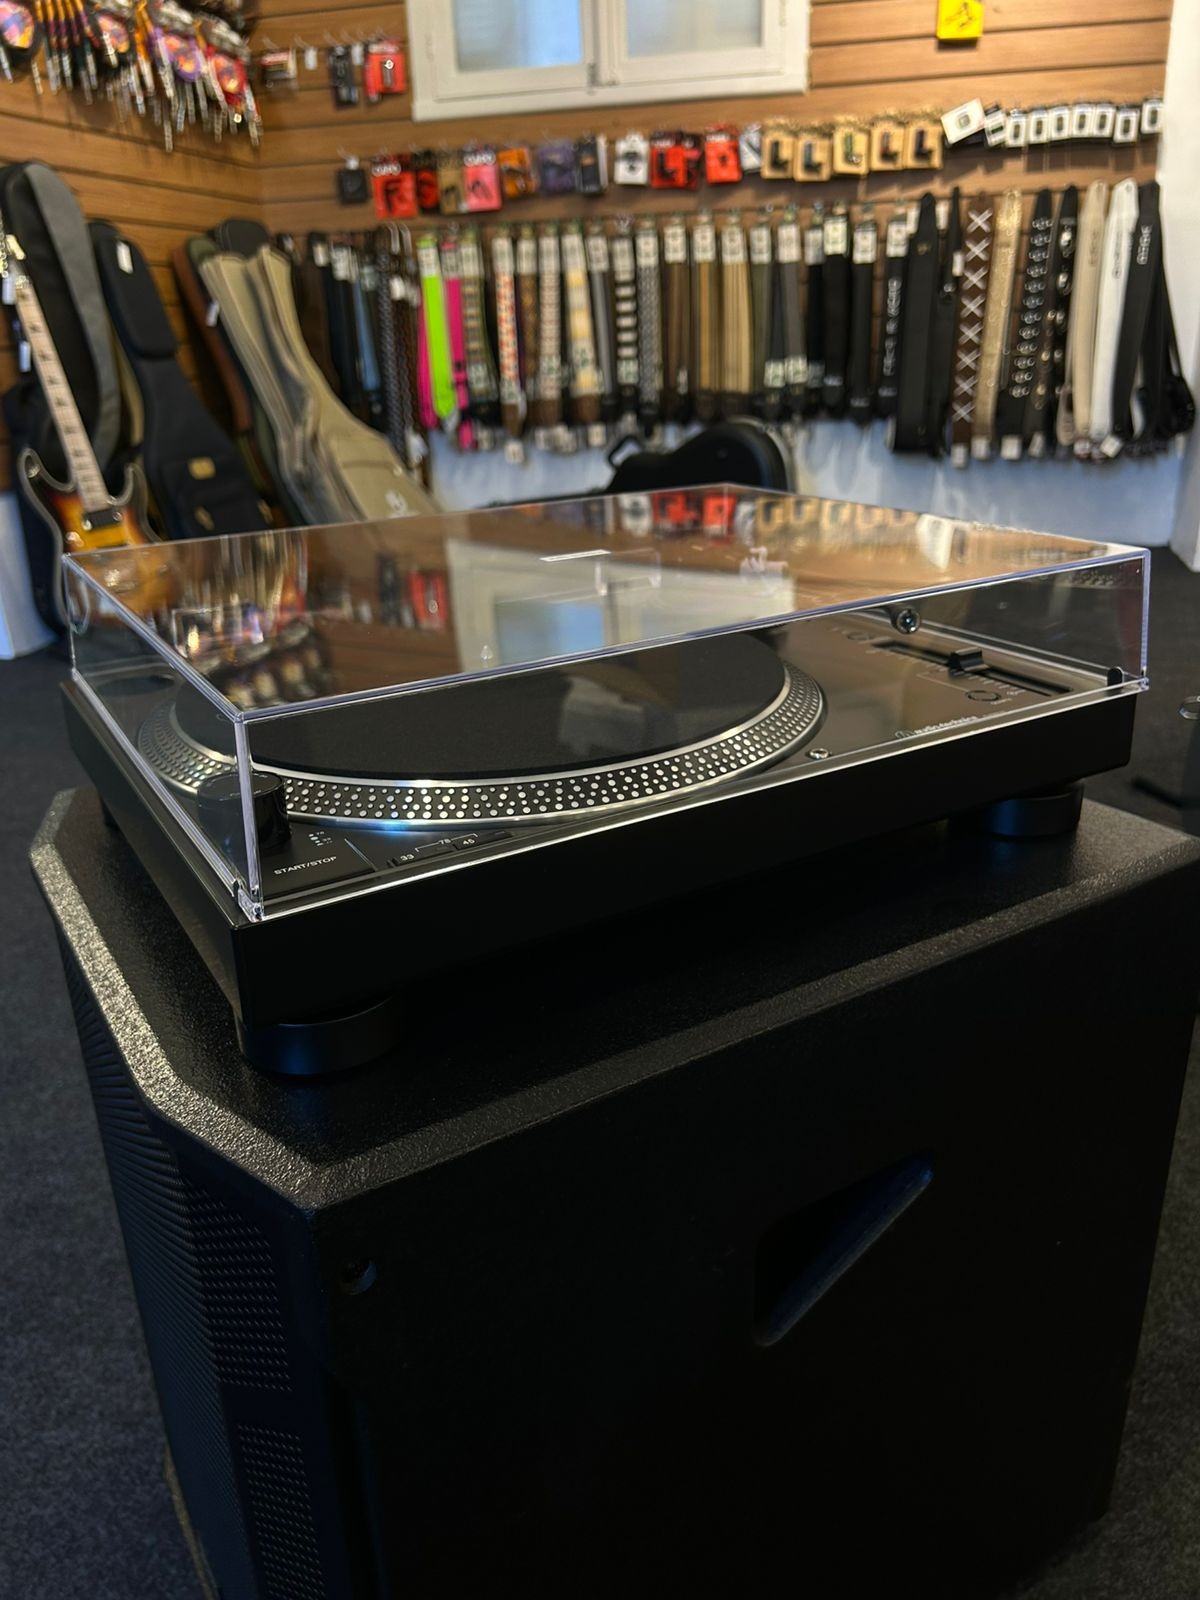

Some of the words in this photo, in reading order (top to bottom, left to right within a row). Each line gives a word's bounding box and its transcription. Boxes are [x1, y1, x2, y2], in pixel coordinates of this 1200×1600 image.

[462, 838, 476, 846] 45
[399, 853, 415, 862] 33
[273, 855, 338, 875] START/STOP
